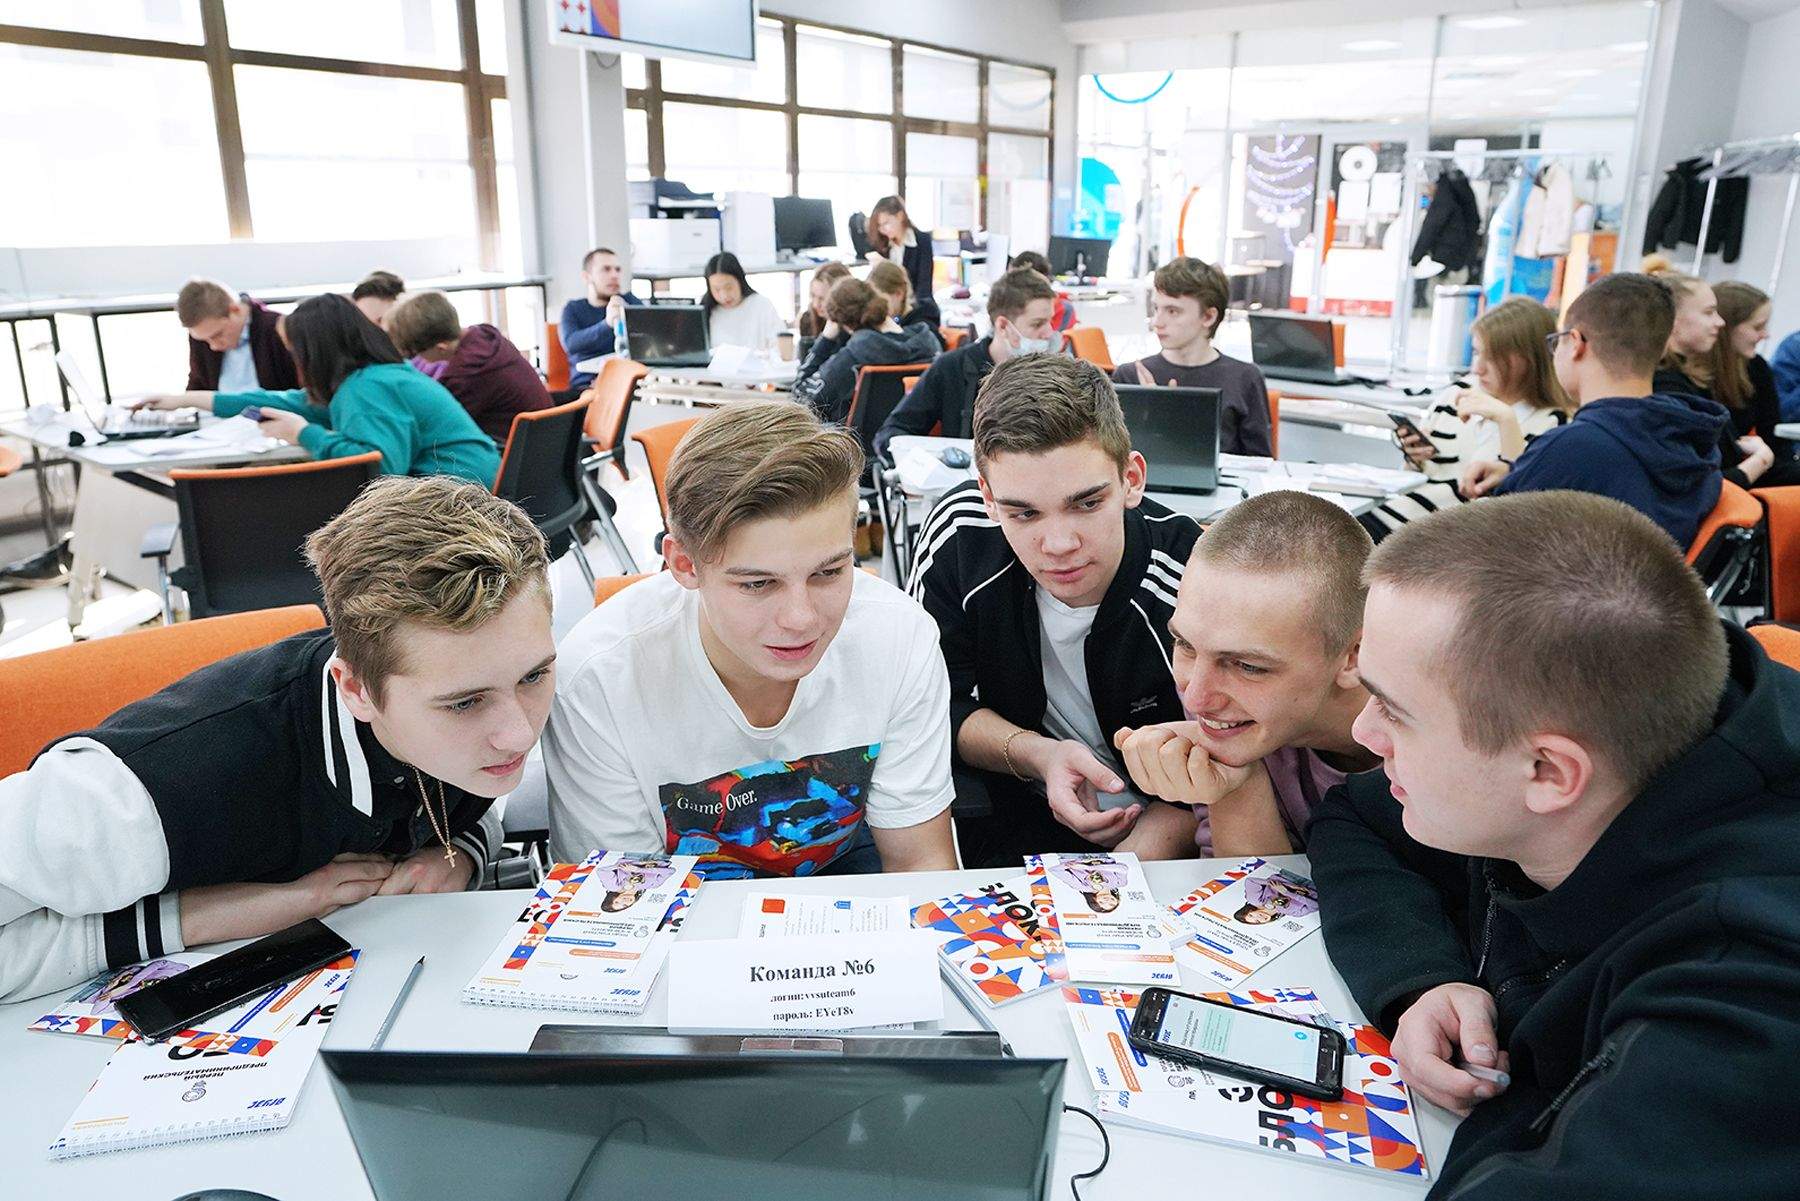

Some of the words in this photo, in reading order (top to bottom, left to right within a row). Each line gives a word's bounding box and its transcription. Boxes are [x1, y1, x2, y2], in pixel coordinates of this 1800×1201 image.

[677, 797, 723, 815] Game
[725, 789, 758, 812] Over.
[750, 964, 836, 982] Команда
[842, 958, 876, 976] №6
[772, 1011, 813, 1022] пароль:
[143, 1061, 268, 1081] ПРЕДПРИНИМАТЕЛЬСКИЙ
[183, 1071, 225, 1081] ПЕРВЫЙ
